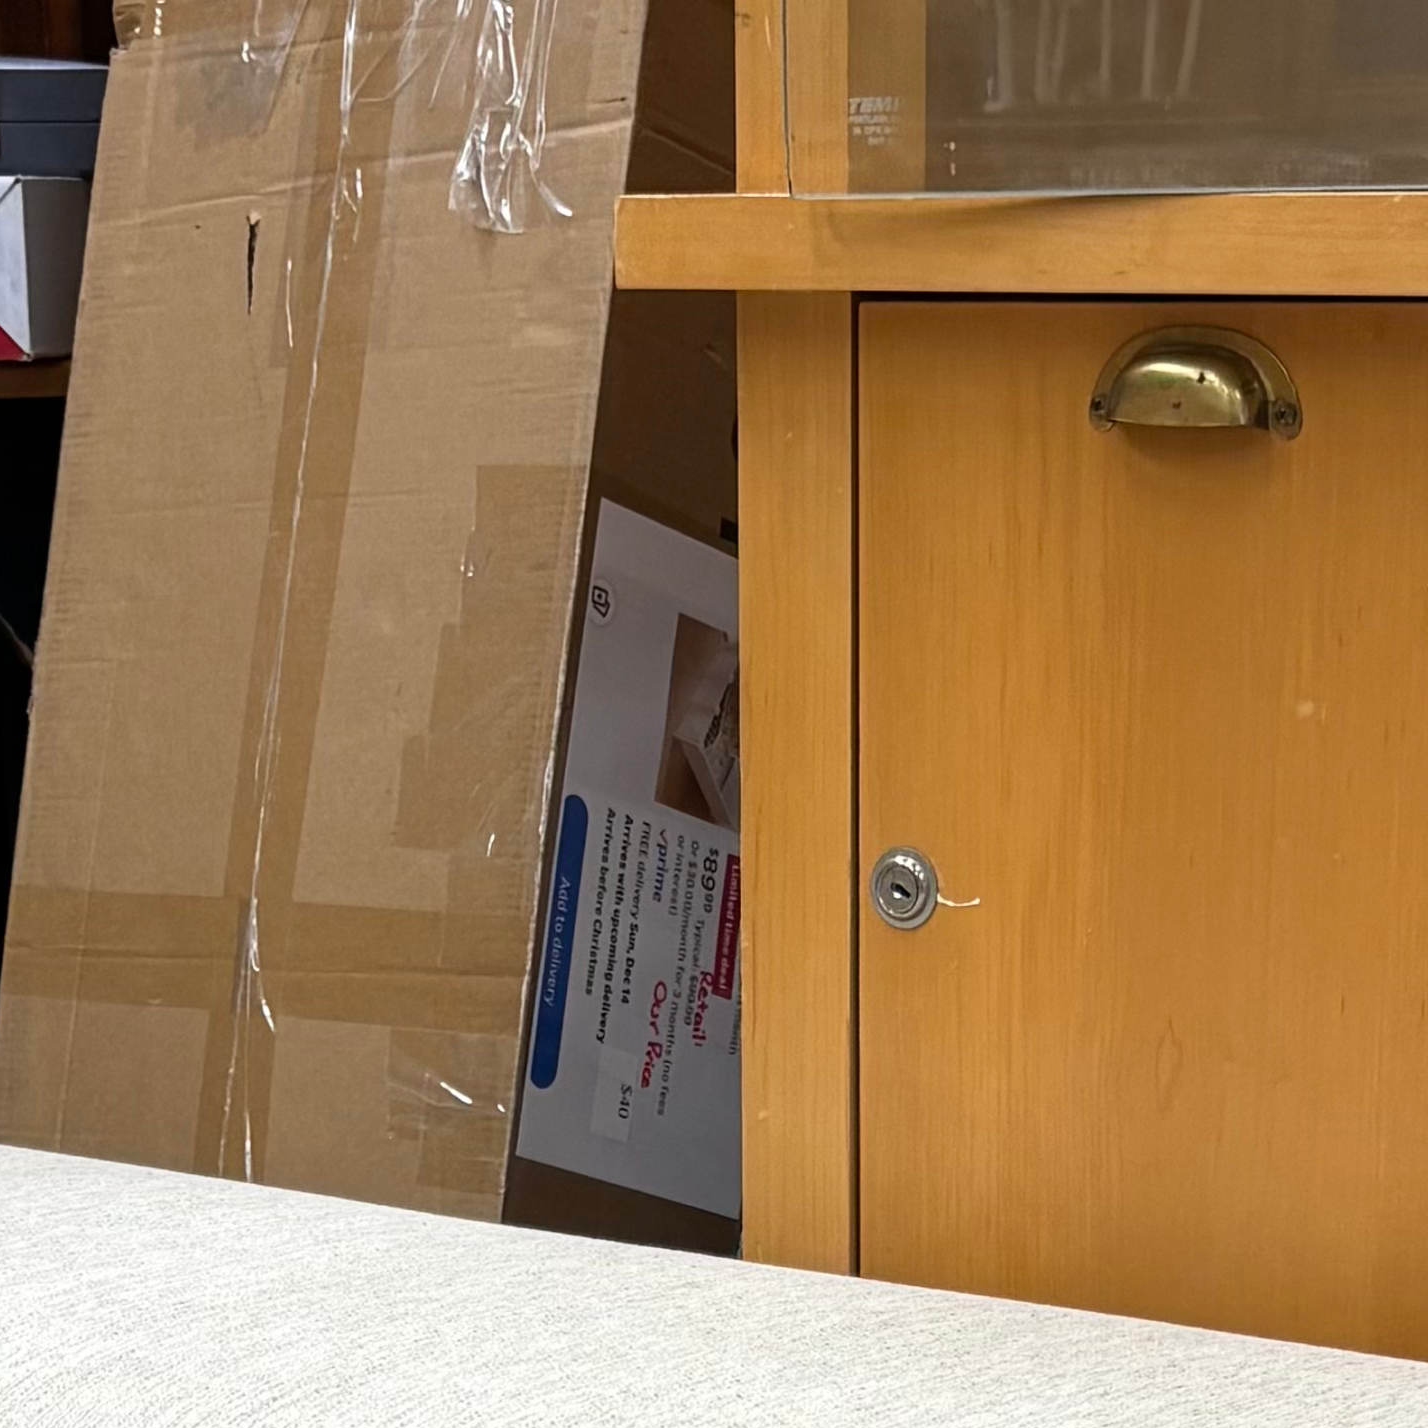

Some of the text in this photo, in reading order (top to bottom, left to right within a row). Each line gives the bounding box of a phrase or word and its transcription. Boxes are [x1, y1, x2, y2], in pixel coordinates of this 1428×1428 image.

[677, 835, 685, 849] or
[653, 843, 669, 903] prime
[585, 807, 616, 996] Arrives before Christmas
[620, 821, 651, 1005] FREE delivery Sun, Dec 14
[543, 875, 571, 1008] Add to delivery
[596, 814, 634, 1044] Arrives with upcoming delivery
[722, 922, 735, 955] time
[675, 966, 685, 987] for
[719, 957, 730, 990] deal
[641, 980, 667, 1089] Our Price
[665, 1002, 678, 1055] months
[618, 1084, 633, 1120] $40
[657, 1085, 669, 1116] fees
